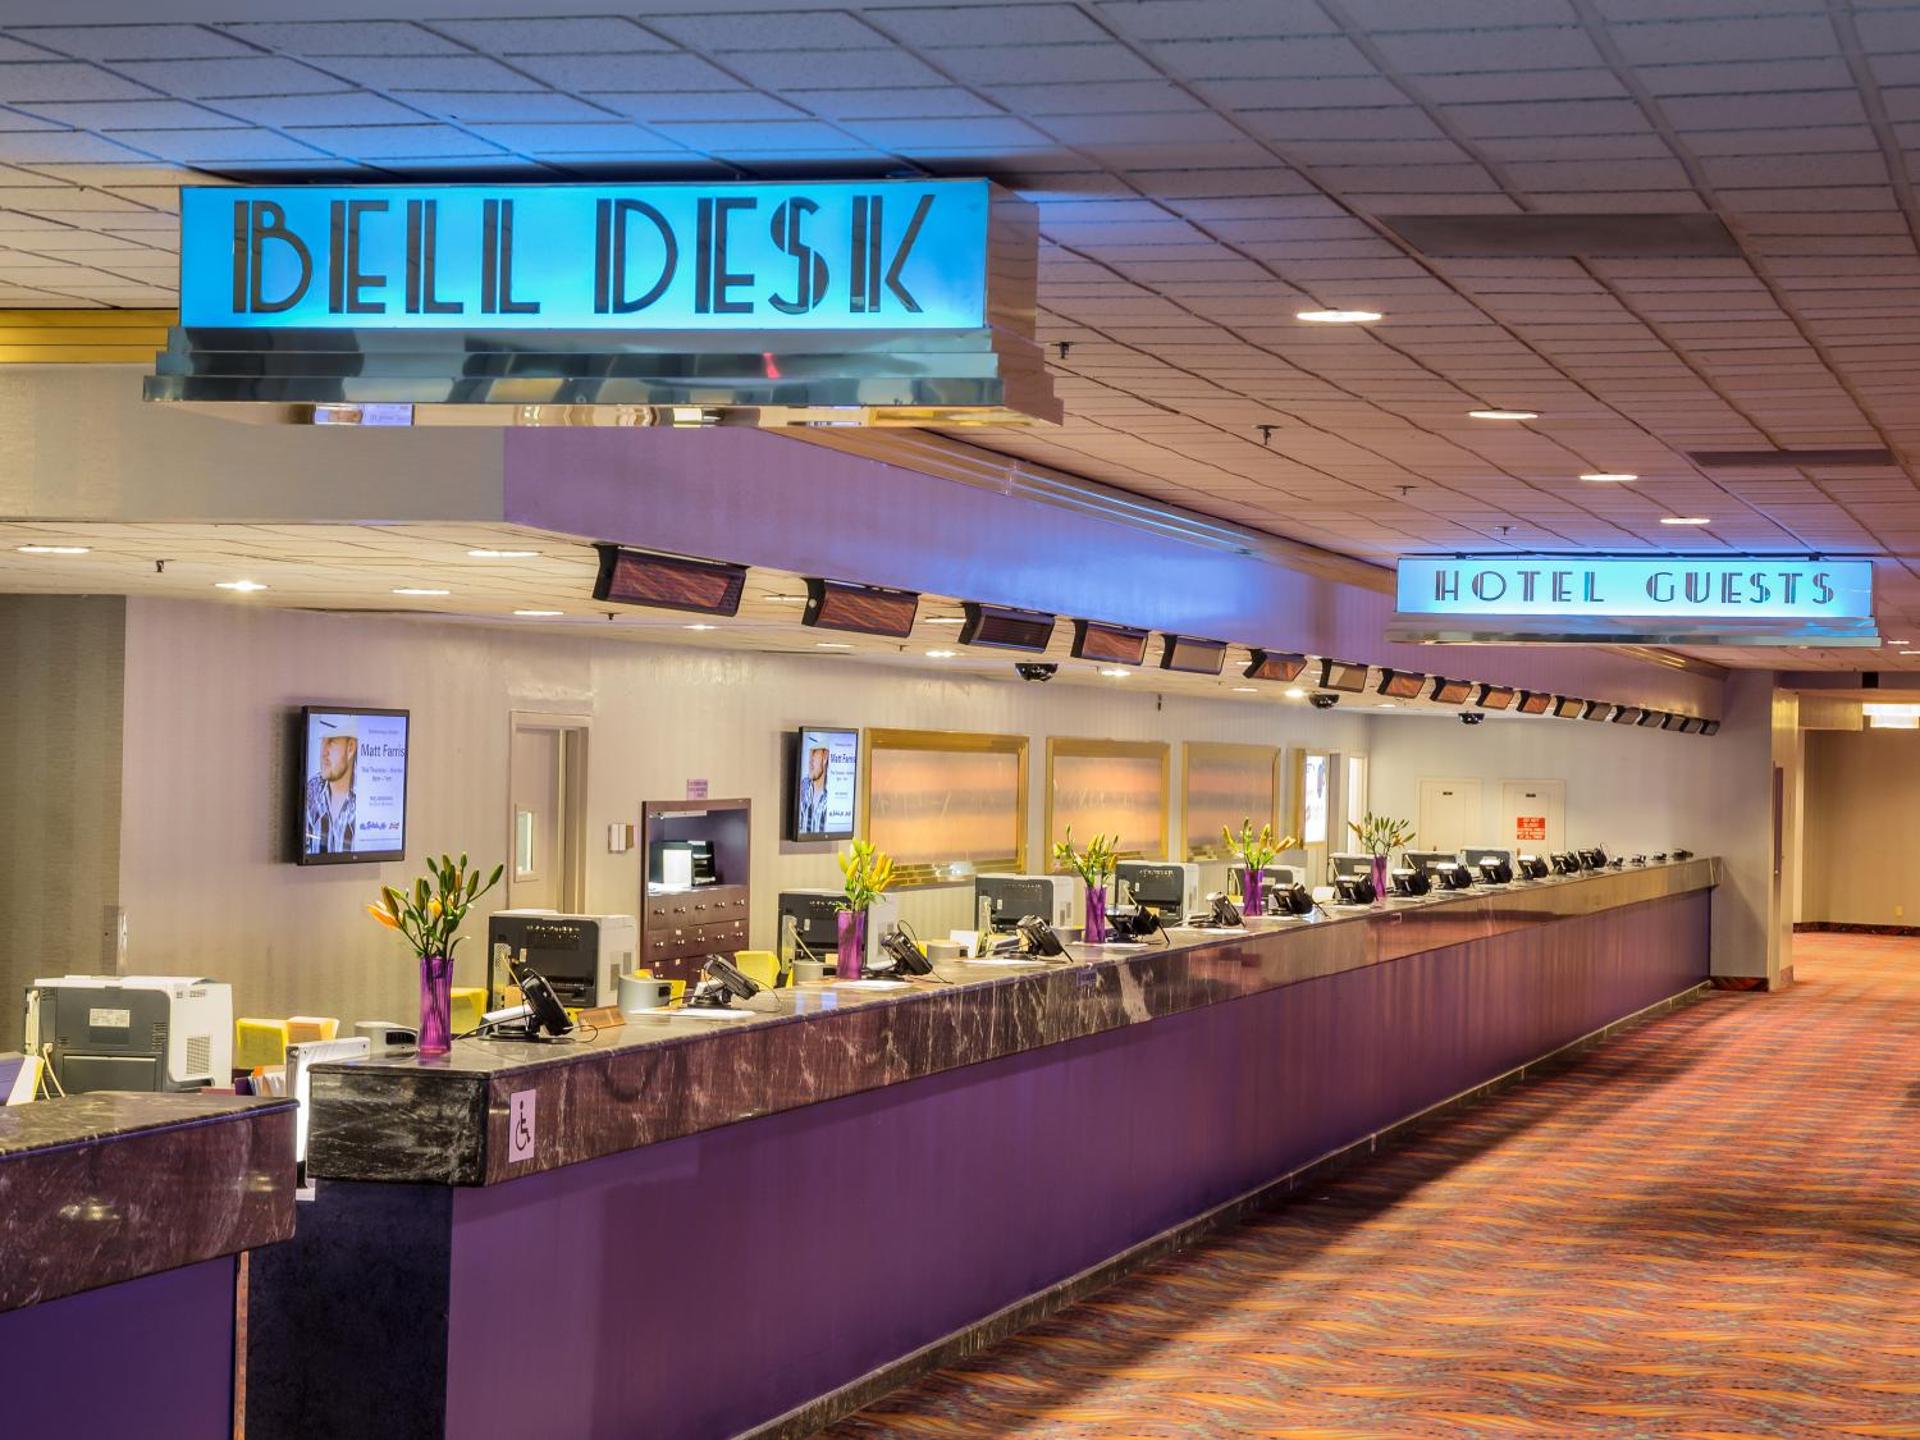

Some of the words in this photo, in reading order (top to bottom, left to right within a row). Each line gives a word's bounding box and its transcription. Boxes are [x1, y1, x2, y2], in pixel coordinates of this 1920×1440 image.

[232, 199, 540, 314] BELL
[594, 194, 936, 315] DESK
[1434, 570, 1605, 602] HOTEL
[1645, 572, 1834, 604] GUESTS
[360, 743, 381, 758] Matt
